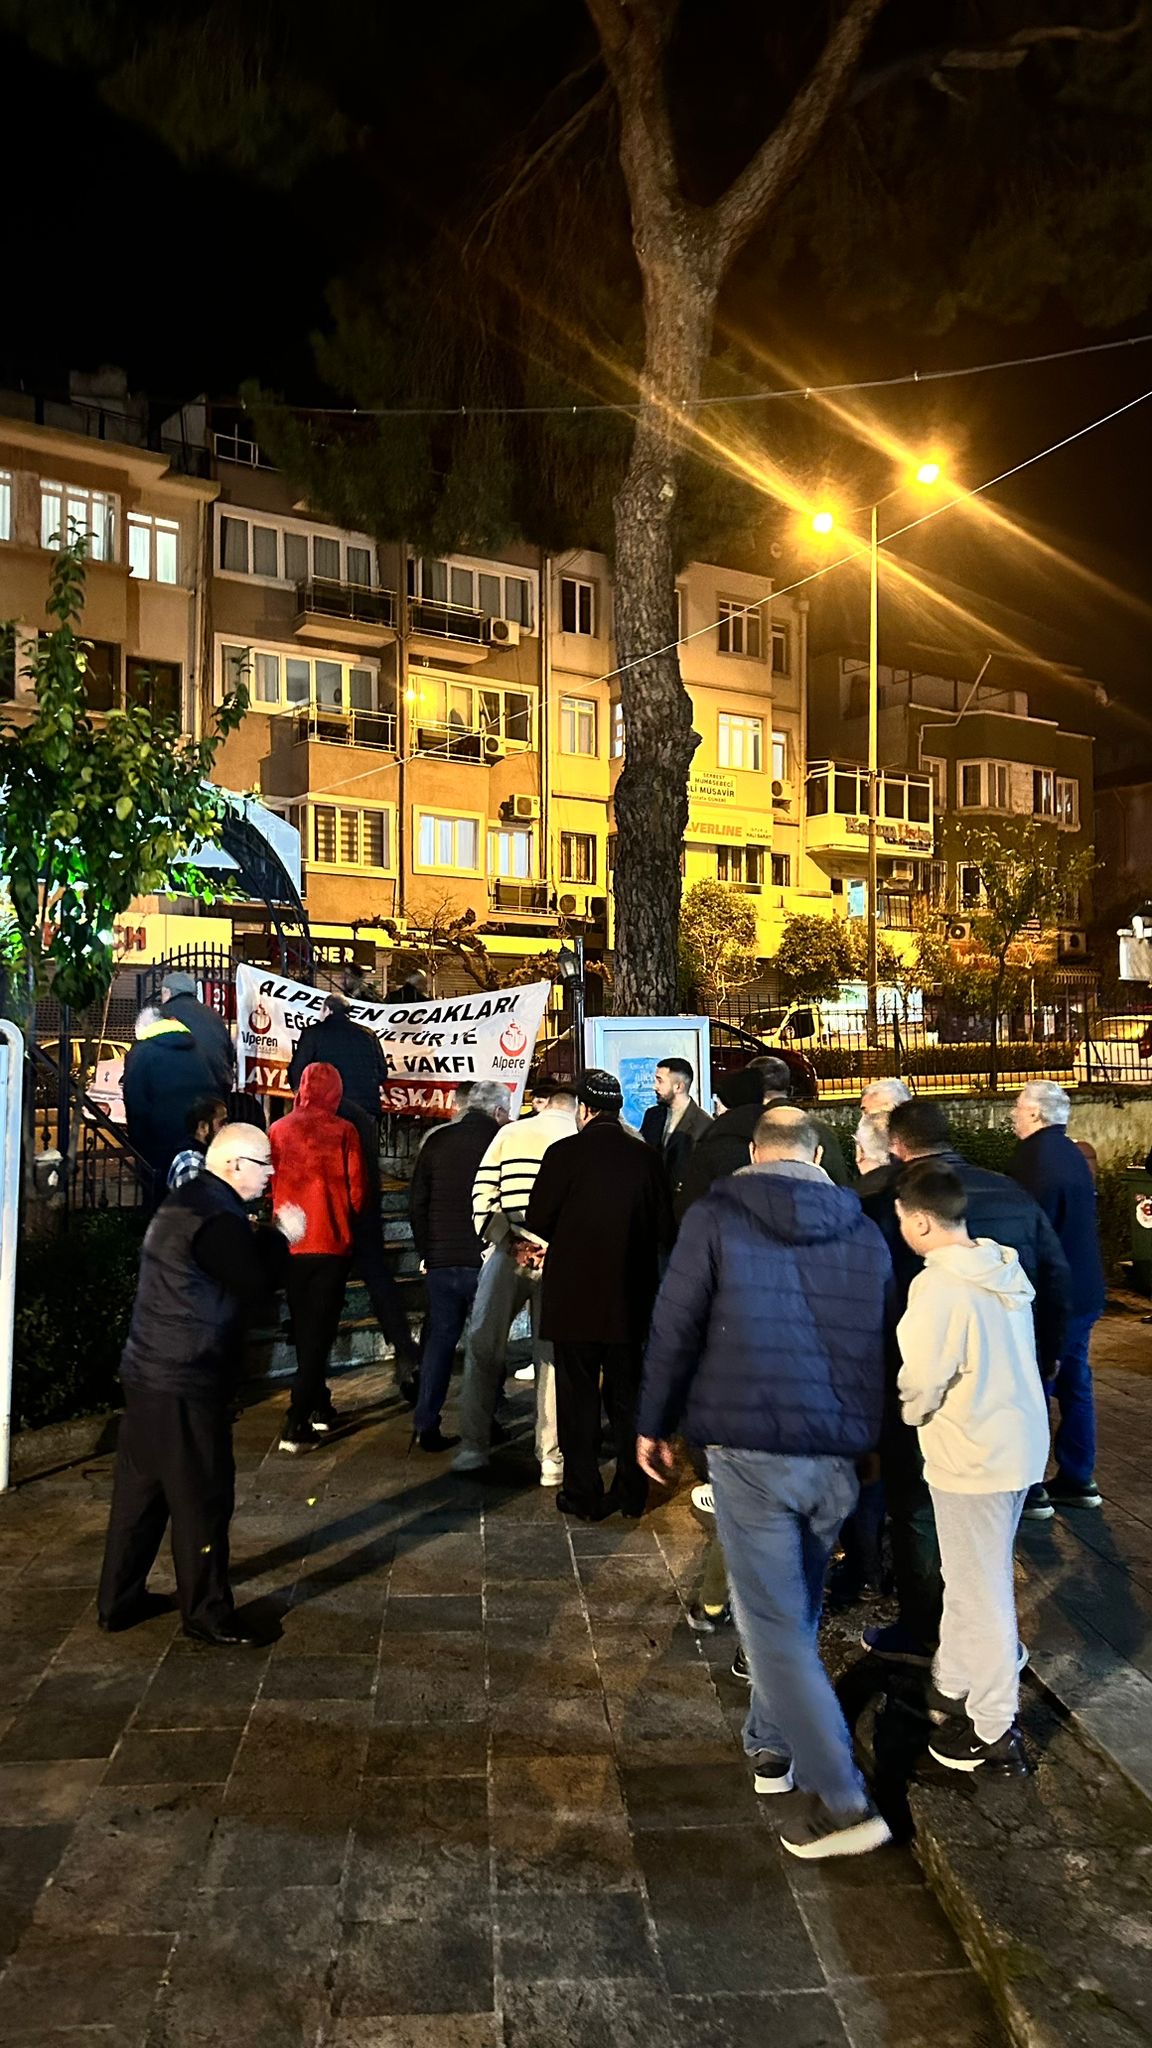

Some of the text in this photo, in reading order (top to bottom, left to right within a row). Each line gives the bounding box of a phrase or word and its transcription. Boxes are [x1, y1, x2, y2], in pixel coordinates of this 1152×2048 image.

[259, 980, 385, 1022] ALPEEN
[388, 994, 521, 1025] OCAKLARI
[375, 1028, 445, 1047] ÜLTÜR
[403, 1055, 475, 1073] VAKFI
[491, 1055, 526, 1071] Alpere
